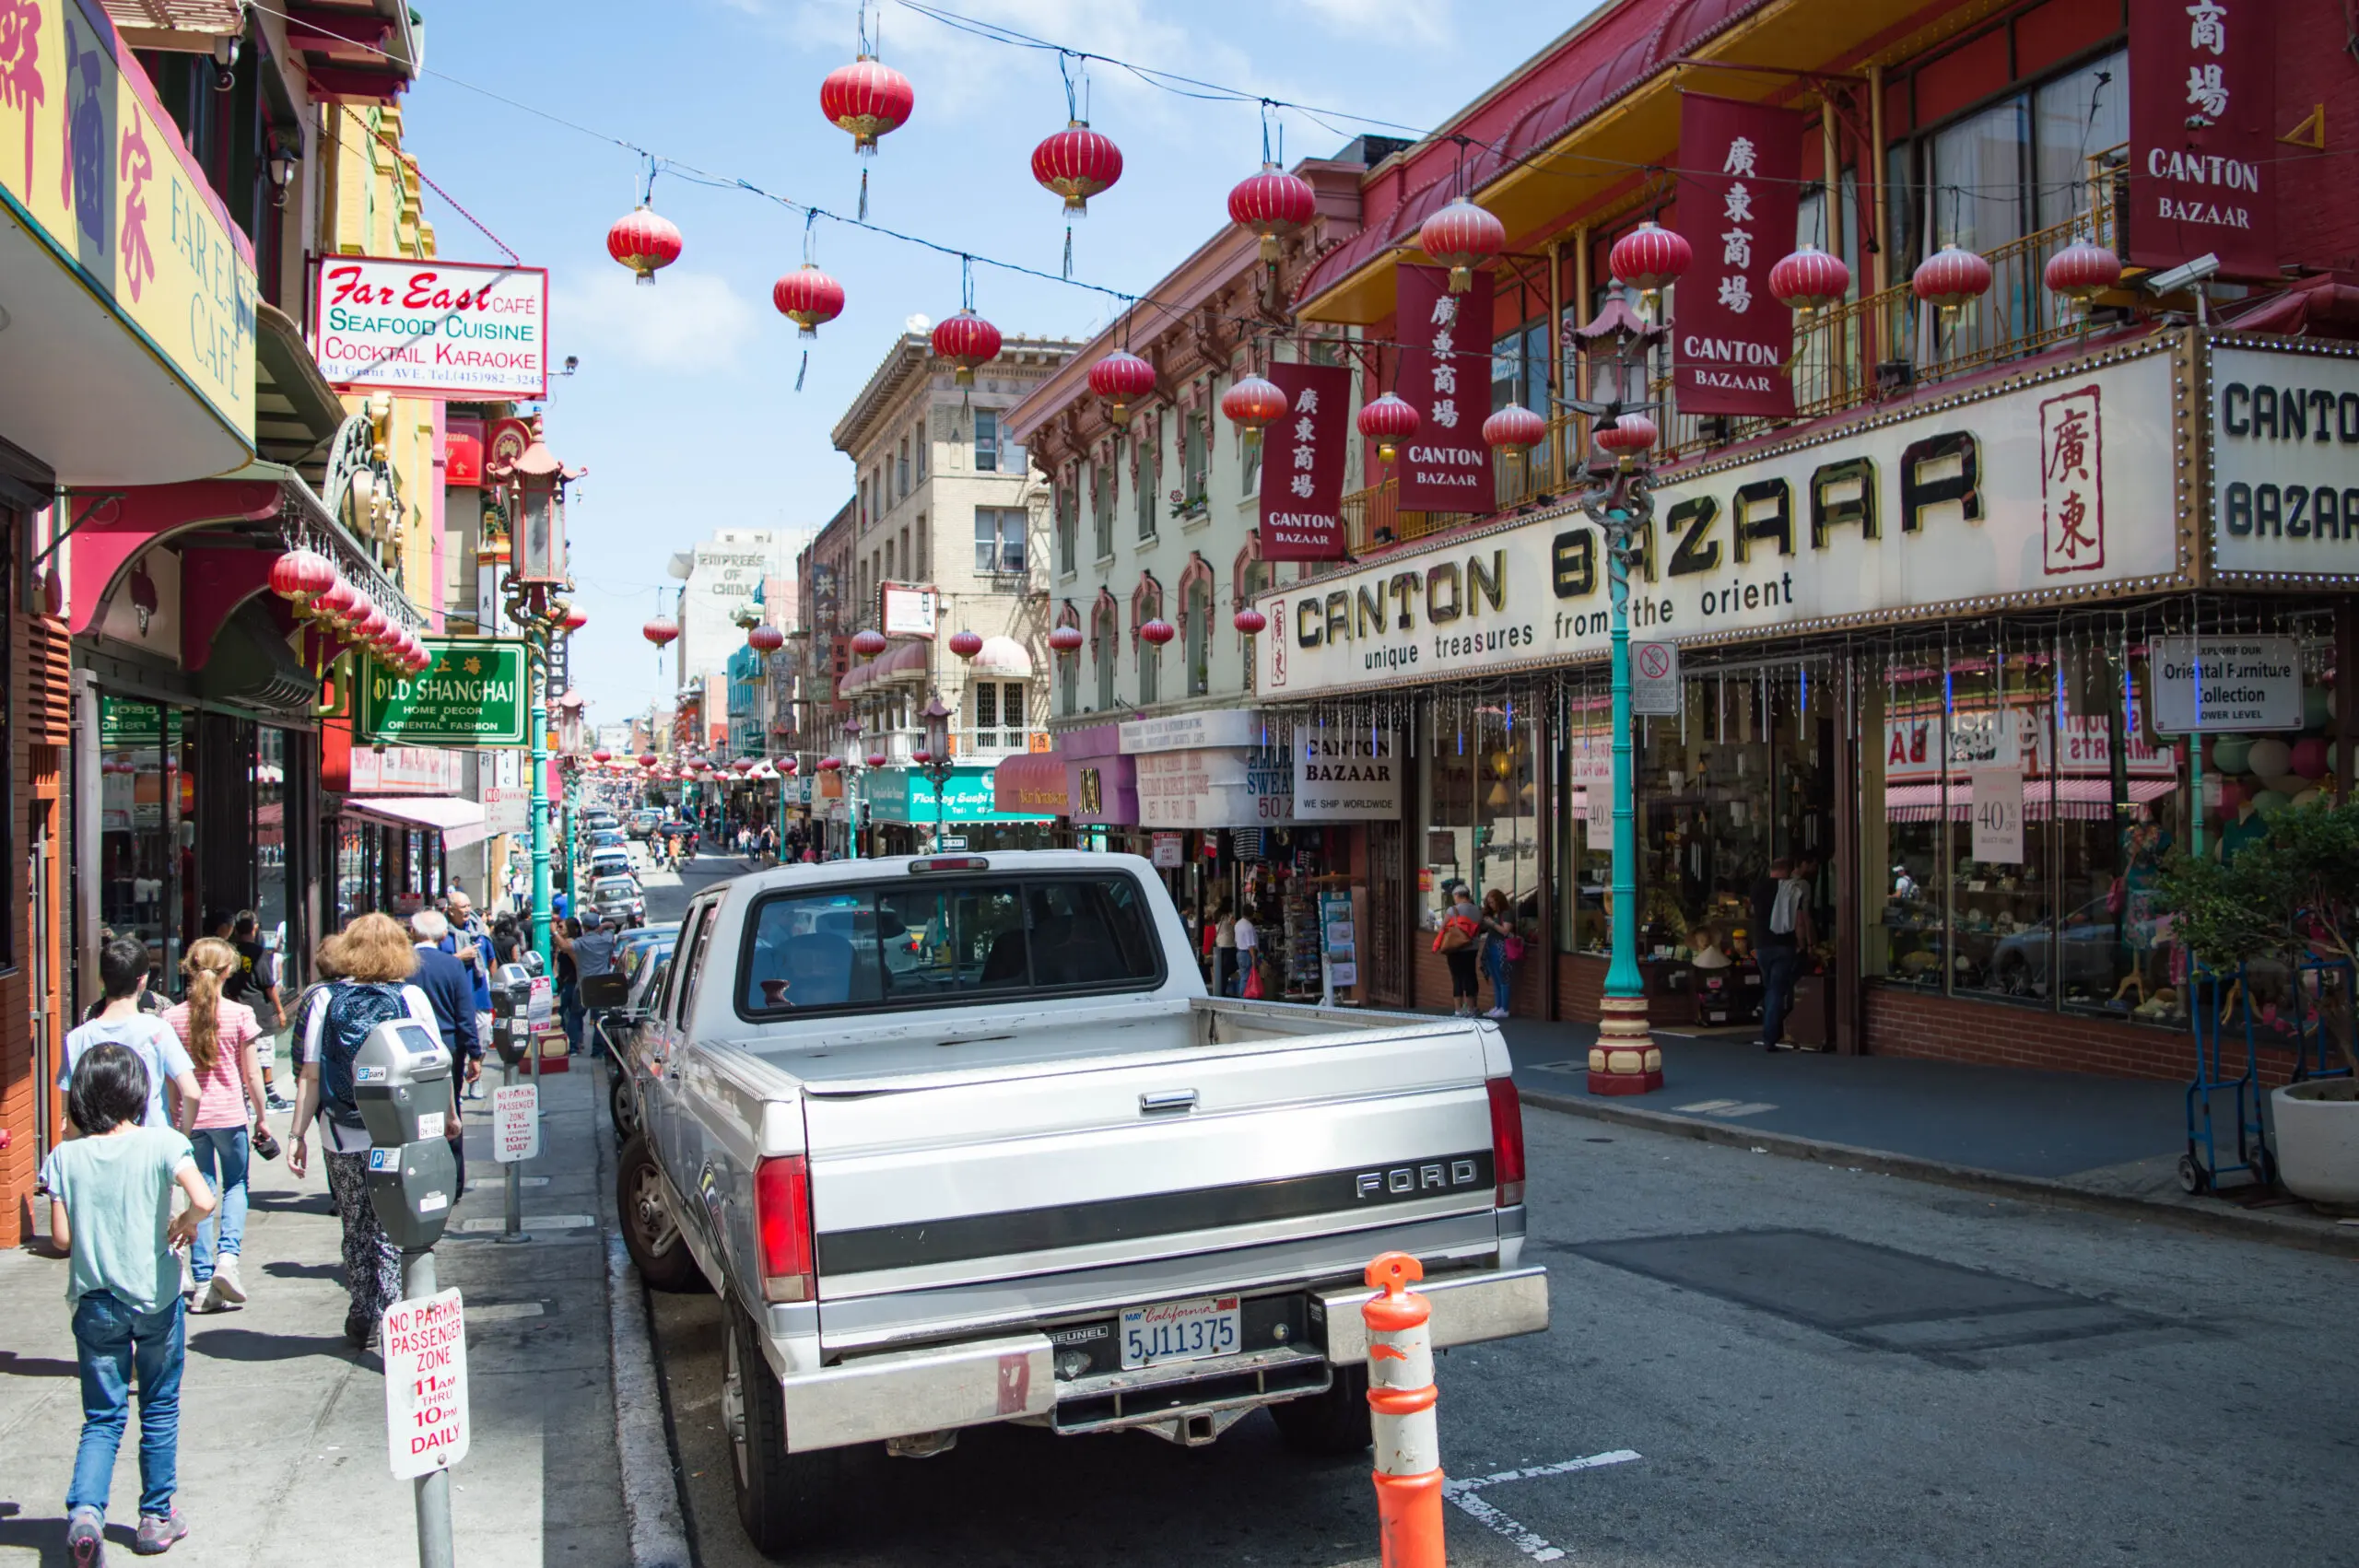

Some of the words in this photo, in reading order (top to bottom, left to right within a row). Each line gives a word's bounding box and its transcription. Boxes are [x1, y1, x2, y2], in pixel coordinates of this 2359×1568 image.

[2148, 148, 2258, 193] CANTON
[2159, 197, 2250, 229] BAZAAR
[170, 174, 208, 292] FAR
[1718, 136, 1757, 314] 廣東商場
[328, 266, 394, 305] Far
[403, 273, 491, 311] East
[493, 296, 536, 315] CAFÉ
[330, 308, 436, 336] SEAFOOD
[446, 315, 534, 341] CUISINE
[325, 336, 427, 364] COCKTAIL
[436, 343, 537, 369] KARAOKE
[1684, 335, 1779, 366] CANTON
[1695, 369, 1771, 392] BAZAAR
[1409, 446, 1484, 466] CANTON
[1416, 472, 1477, 487] BAZAAR
[2048, 409, 2096, 560] 廣東
[1269, 511, 1335, 530] CANTON
[1275, 532, 1329, 545] BAZAAR
[723, 568, 742, 579] OF
[1297, 548, 1508, 649] CANTON
[1365, 645, 1419, 671] unique
[1436, 624, 1533, 659] treasures
[1555, 612, 1608, 639] from
[1633, 596, 1674, 627] the
[1701, 572, 1793, 615] orient
[2199, 647, 2237, 656] XPLORE
[373, 678, 411, 701] OLD
[417, 679, 513, 703] SHANGHAI
[403, 706, 437, 715] HOME
[443, 706, 484, 716] DECOR
[440, 714, 447, 722] &
[2201, 710, 2228, 720] OWER
[2233, 710, 2263, 720] LEVEL
[388, 720, 443, 731] ORIENTAL
[450, 721, 499, 731] FASHION
[1305, 739, 1389, 757] CANTON
[1306, 765, 1391, 782] BAZAAR
[1304, 799, 1317, 809] WE
[1320, 799, 1340, 809] SHIP
[1344, 799, 1393, 809] WORLDWIDE
[1978, 800, 2004, 831] 40
[497, 1091, 507, 1101] NO
[510, 1087, 536, 1100] PARKING
[498, 1100, 535, 1112] PASSENGER
[509, 1112, 526, 1122] ZONE
[507, 1143, 528, 1153] DAILY
[1356, 1159, 1477, 1199] FORD
[389, 1313, 410, 1335] NO
[416, 1296, 461, 1328] PARKING
[1125, 1312, 1143, 1322] MAY
[1145, 1304, 1215, 1324] California
[391, 1318, 462, 1357] PASSENGER
[1128, 1316, 1234, 1360] 5J11375
[417, 1345, 452, 1373] ZONE
[421, 1393, 452, 1407] THRU
[411, 1422, 460, 1455] DAILY
